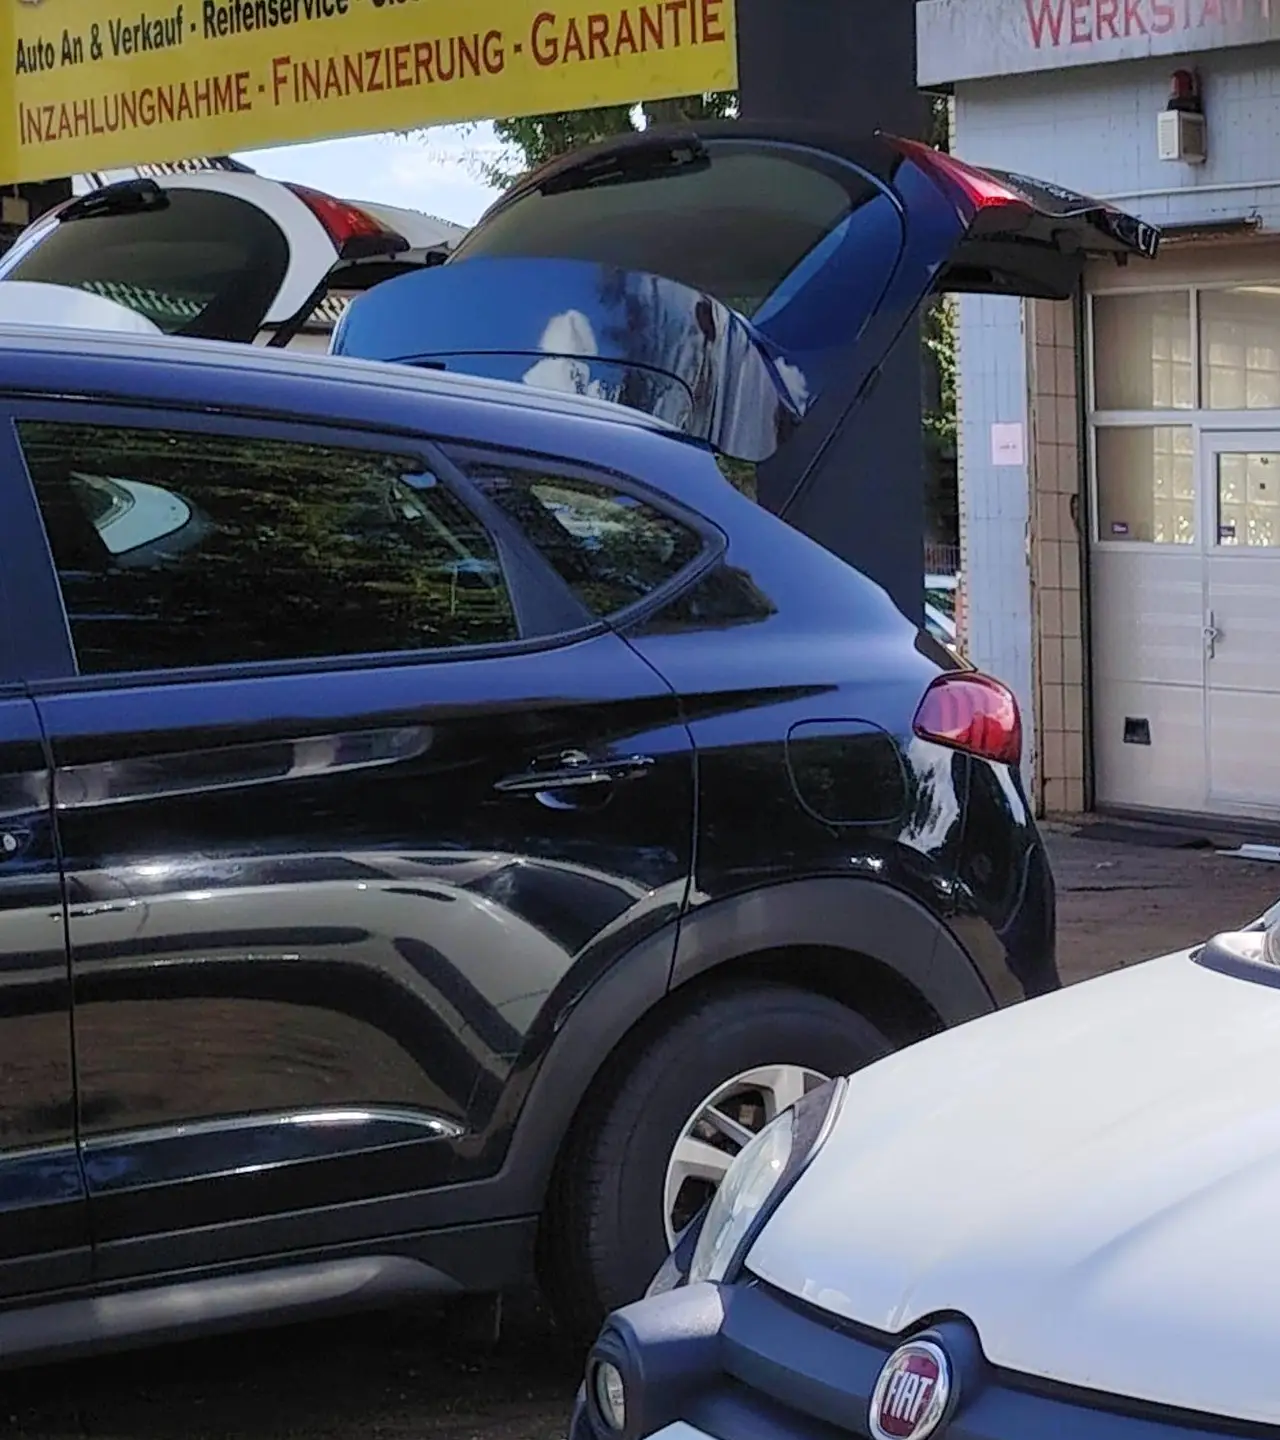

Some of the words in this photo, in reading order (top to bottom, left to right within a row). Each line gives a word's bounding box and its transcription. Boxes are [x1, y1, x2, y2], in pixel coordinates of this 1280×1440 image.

[16, 37, 55, 75] Auto
[61, 29, 84, 67] An
[90, 23, 103, 61] &
[109, 5, 184, 56] Verkauf
[19, 71, 252, 145] INZAHLUNGNAHME
[272, 30, 504, 106] FINANZIERUNG
[531, 0, 725, 66] GARANTIE
[883, 1369, 934, 1423] FIAT
